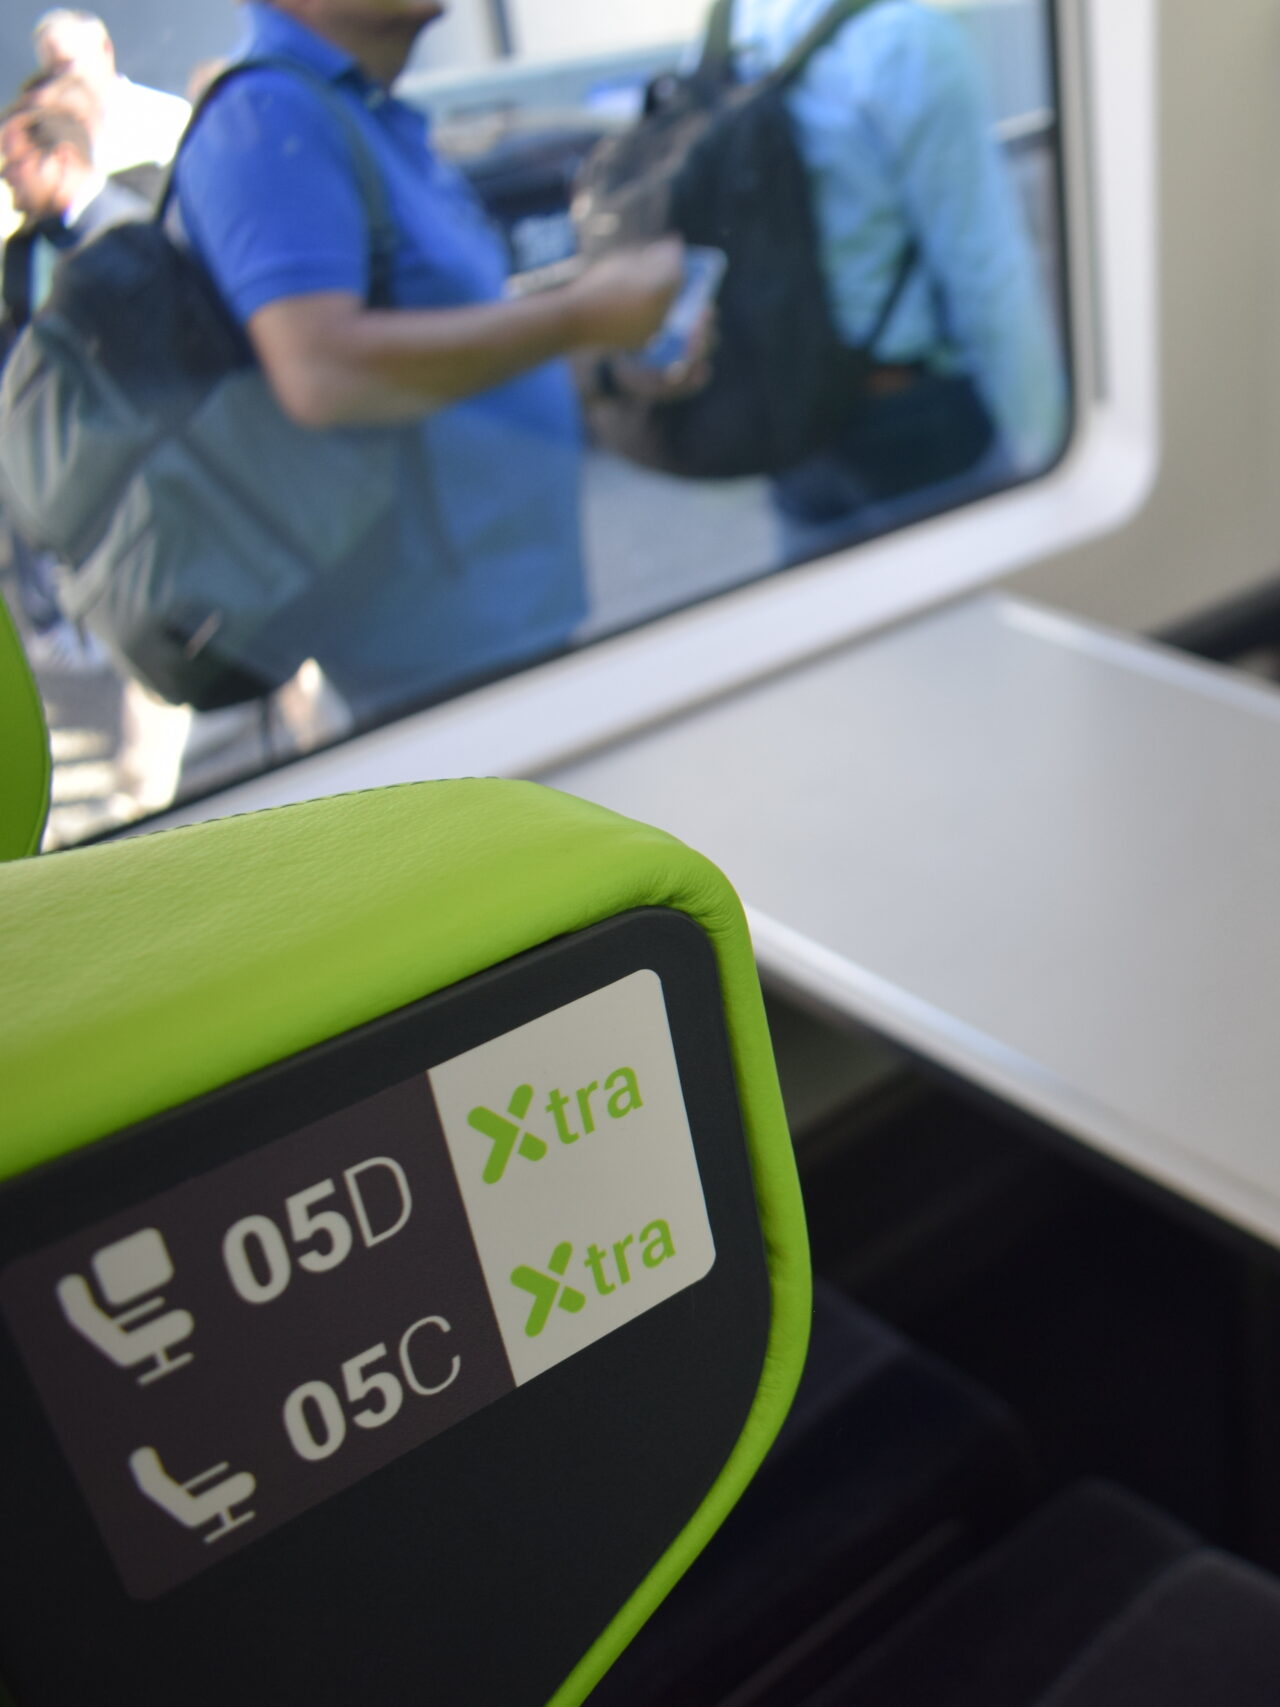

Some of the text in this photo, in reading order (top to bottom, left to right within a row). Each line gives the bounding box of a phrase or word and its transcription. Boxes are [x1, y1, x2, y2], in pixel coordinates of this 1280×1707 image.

[222, 1066, 644, 1304] 05D Xtra
[283, 1218, 677, 1461] 05C Xtra
